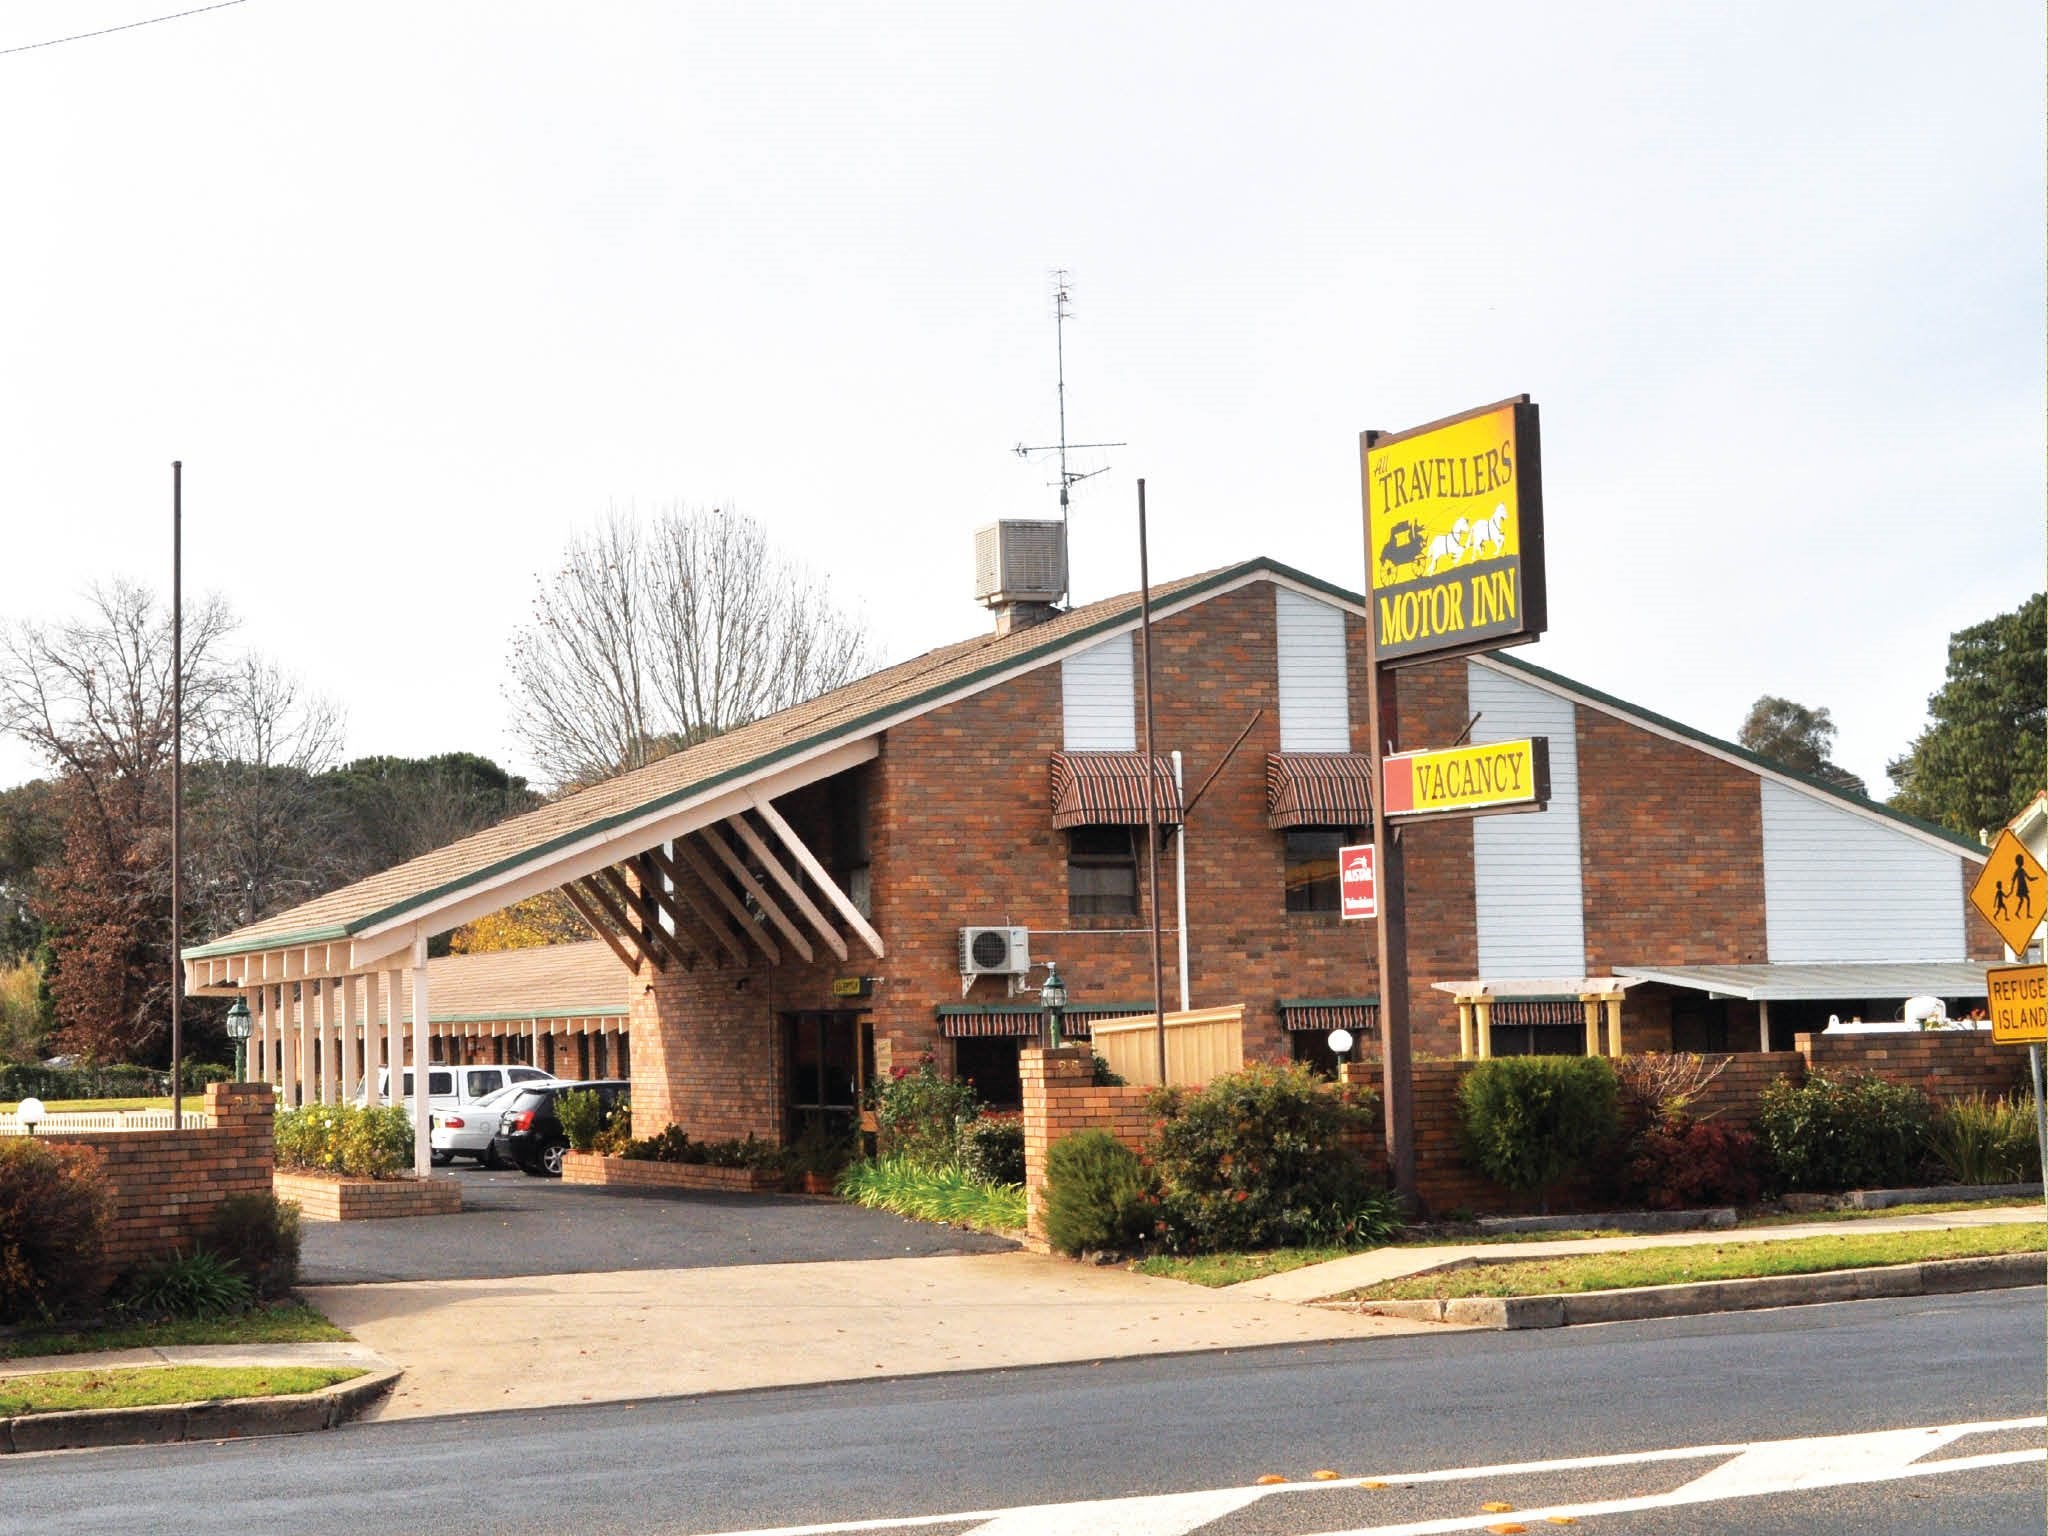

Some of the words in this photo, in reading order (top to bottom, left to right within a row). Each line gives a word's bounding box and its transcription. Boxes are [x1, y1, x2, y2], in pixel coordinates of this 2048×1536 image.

[1374, 455, 1389, 475] All
[1379, 440, 1513, 514] TRAVELLERS
[1381, 581, 1464, 645] MOTOR
[1471, 567, 1516, 628] INN
[1416, 752, 1524, 801] VACANCY
[1994, 977, 2046, 1000] REFUGE
[1998, 1006, 2048, 1030] ISLAND
